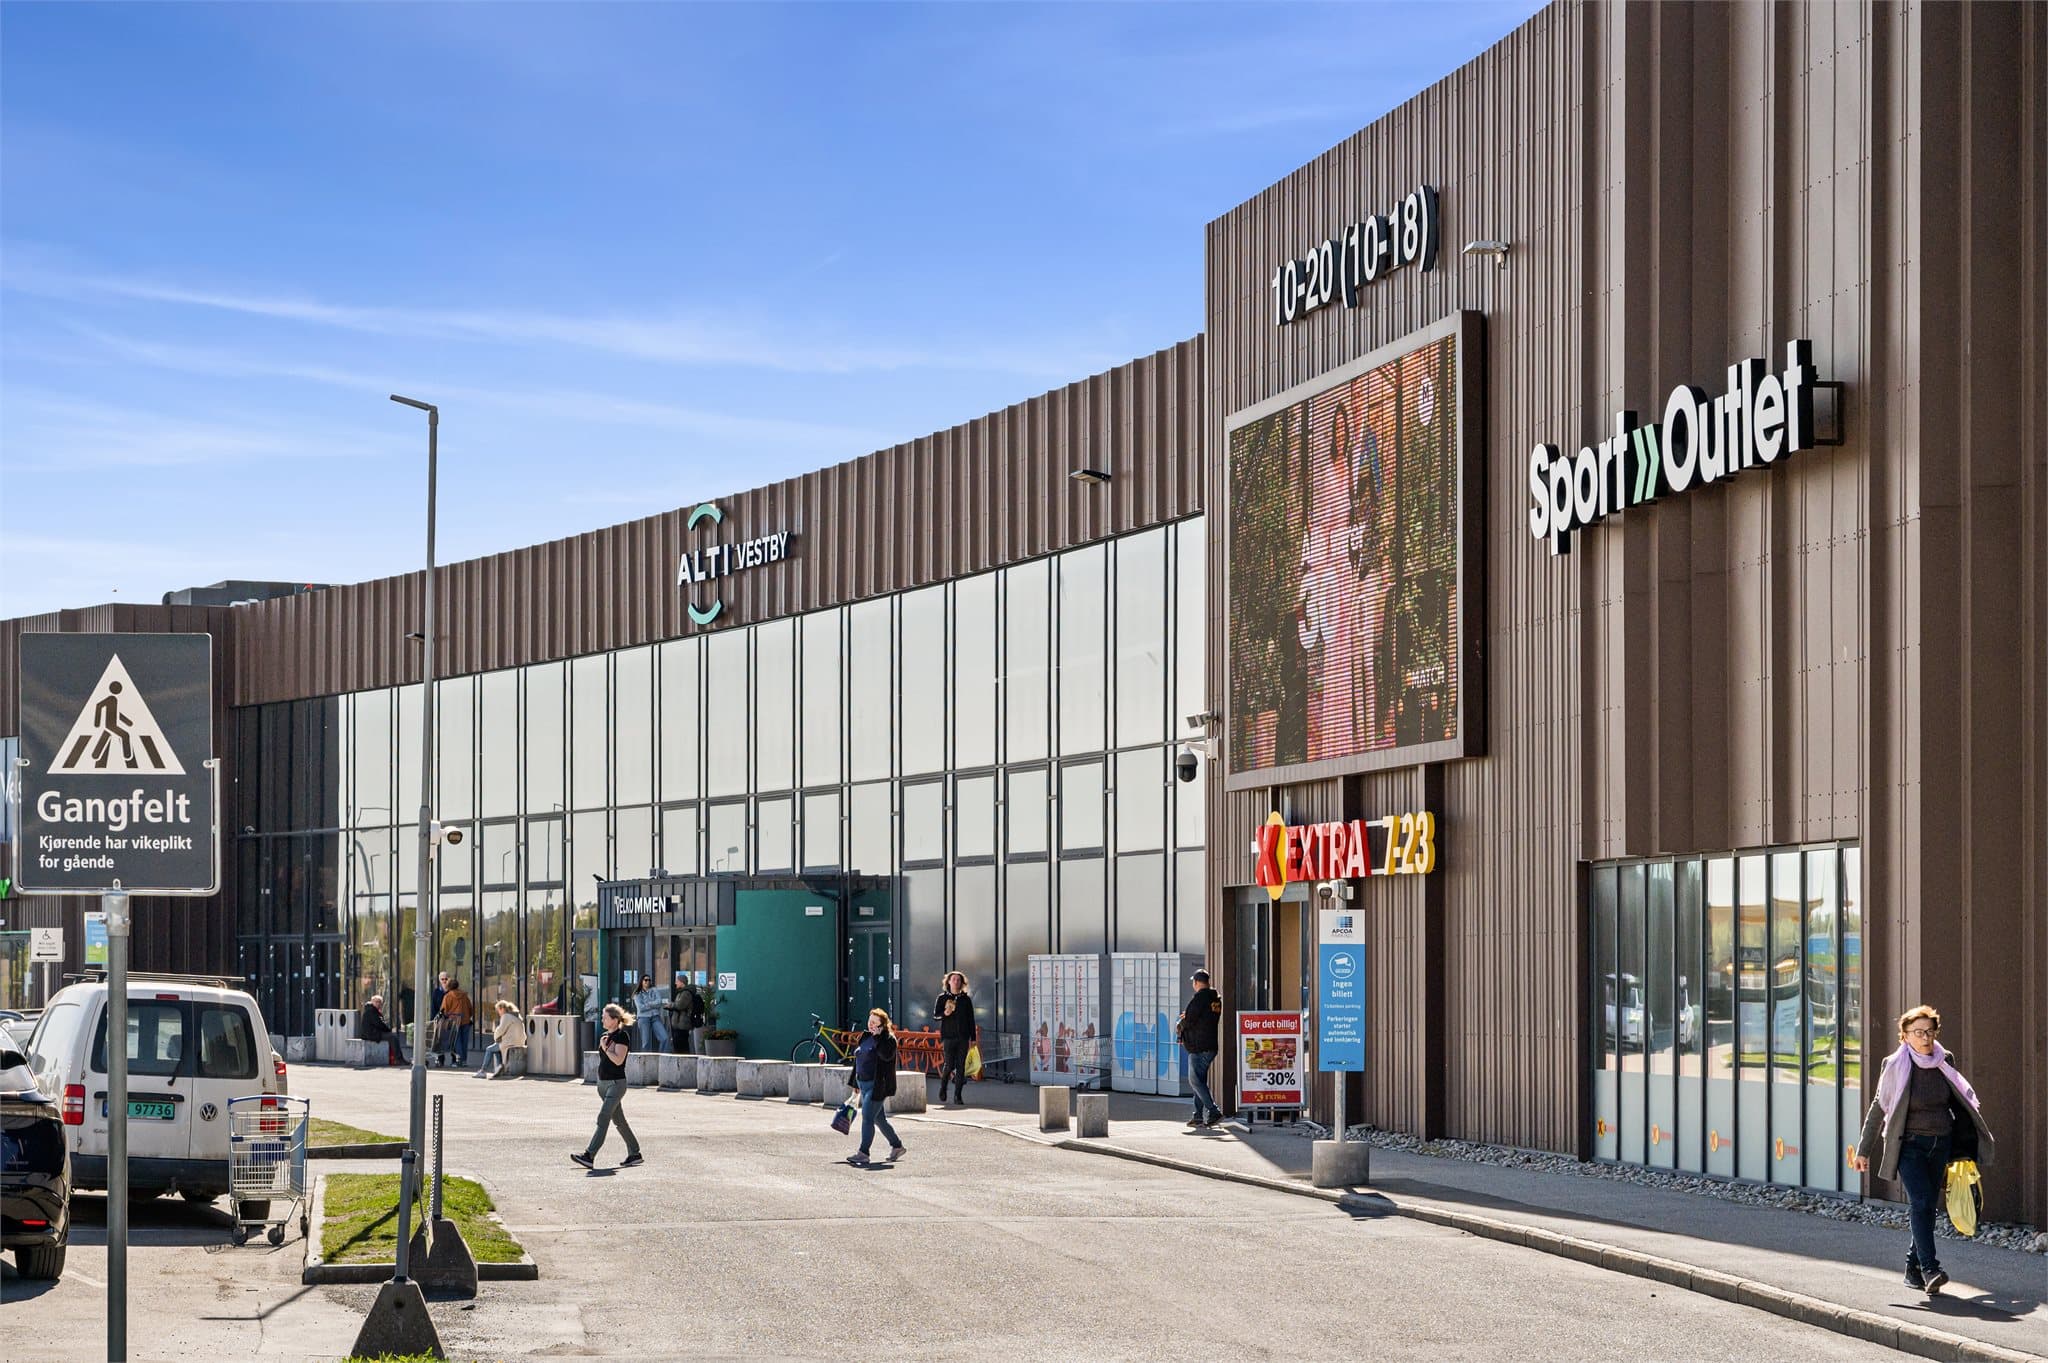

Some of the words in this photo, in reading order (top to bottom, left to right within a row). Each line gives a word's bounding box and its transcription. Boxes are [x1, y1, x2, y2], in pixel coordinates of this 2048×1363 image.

[1273, 238, 1335, 326] 10-20
[1340, 184, 1437, 307] (10-18)
[1530, 412, 1628, 555] Sport
[1662, 340, 1808, 492] Outlet
[677, 544, 730, 586] ALTI
[736, 531, 790, 569] VESTBY
[1412, 660, 1444, 690] MATCH
[37, 789, 191, 831] Gangfelt
[39, 835, 101, 852] Kjørende
[105, 835, 128, 850] har
[132, 835, 192, 853] vikeplikt
[1285, 819, 1370, 881] EXTRA
[1382, 810, 1436, 876] 7-23
[39, 854, 59, 869] for
[63, 854, 114, 872] gående
[615, 896, 667, 914] VELKOMMEN
[1332, 980, 1353, 989] Ingen
[1331, 990, 1353, 998] billett
[1244, 1019, 1261, 1030] Gjør
[1262, 1019, 1275, 1029] det
[1276, 1019, 1298, 1031] billig!
[1262, 1071, 1296, 1086] -30%
[135, 1103, 171, 1116] 97736
